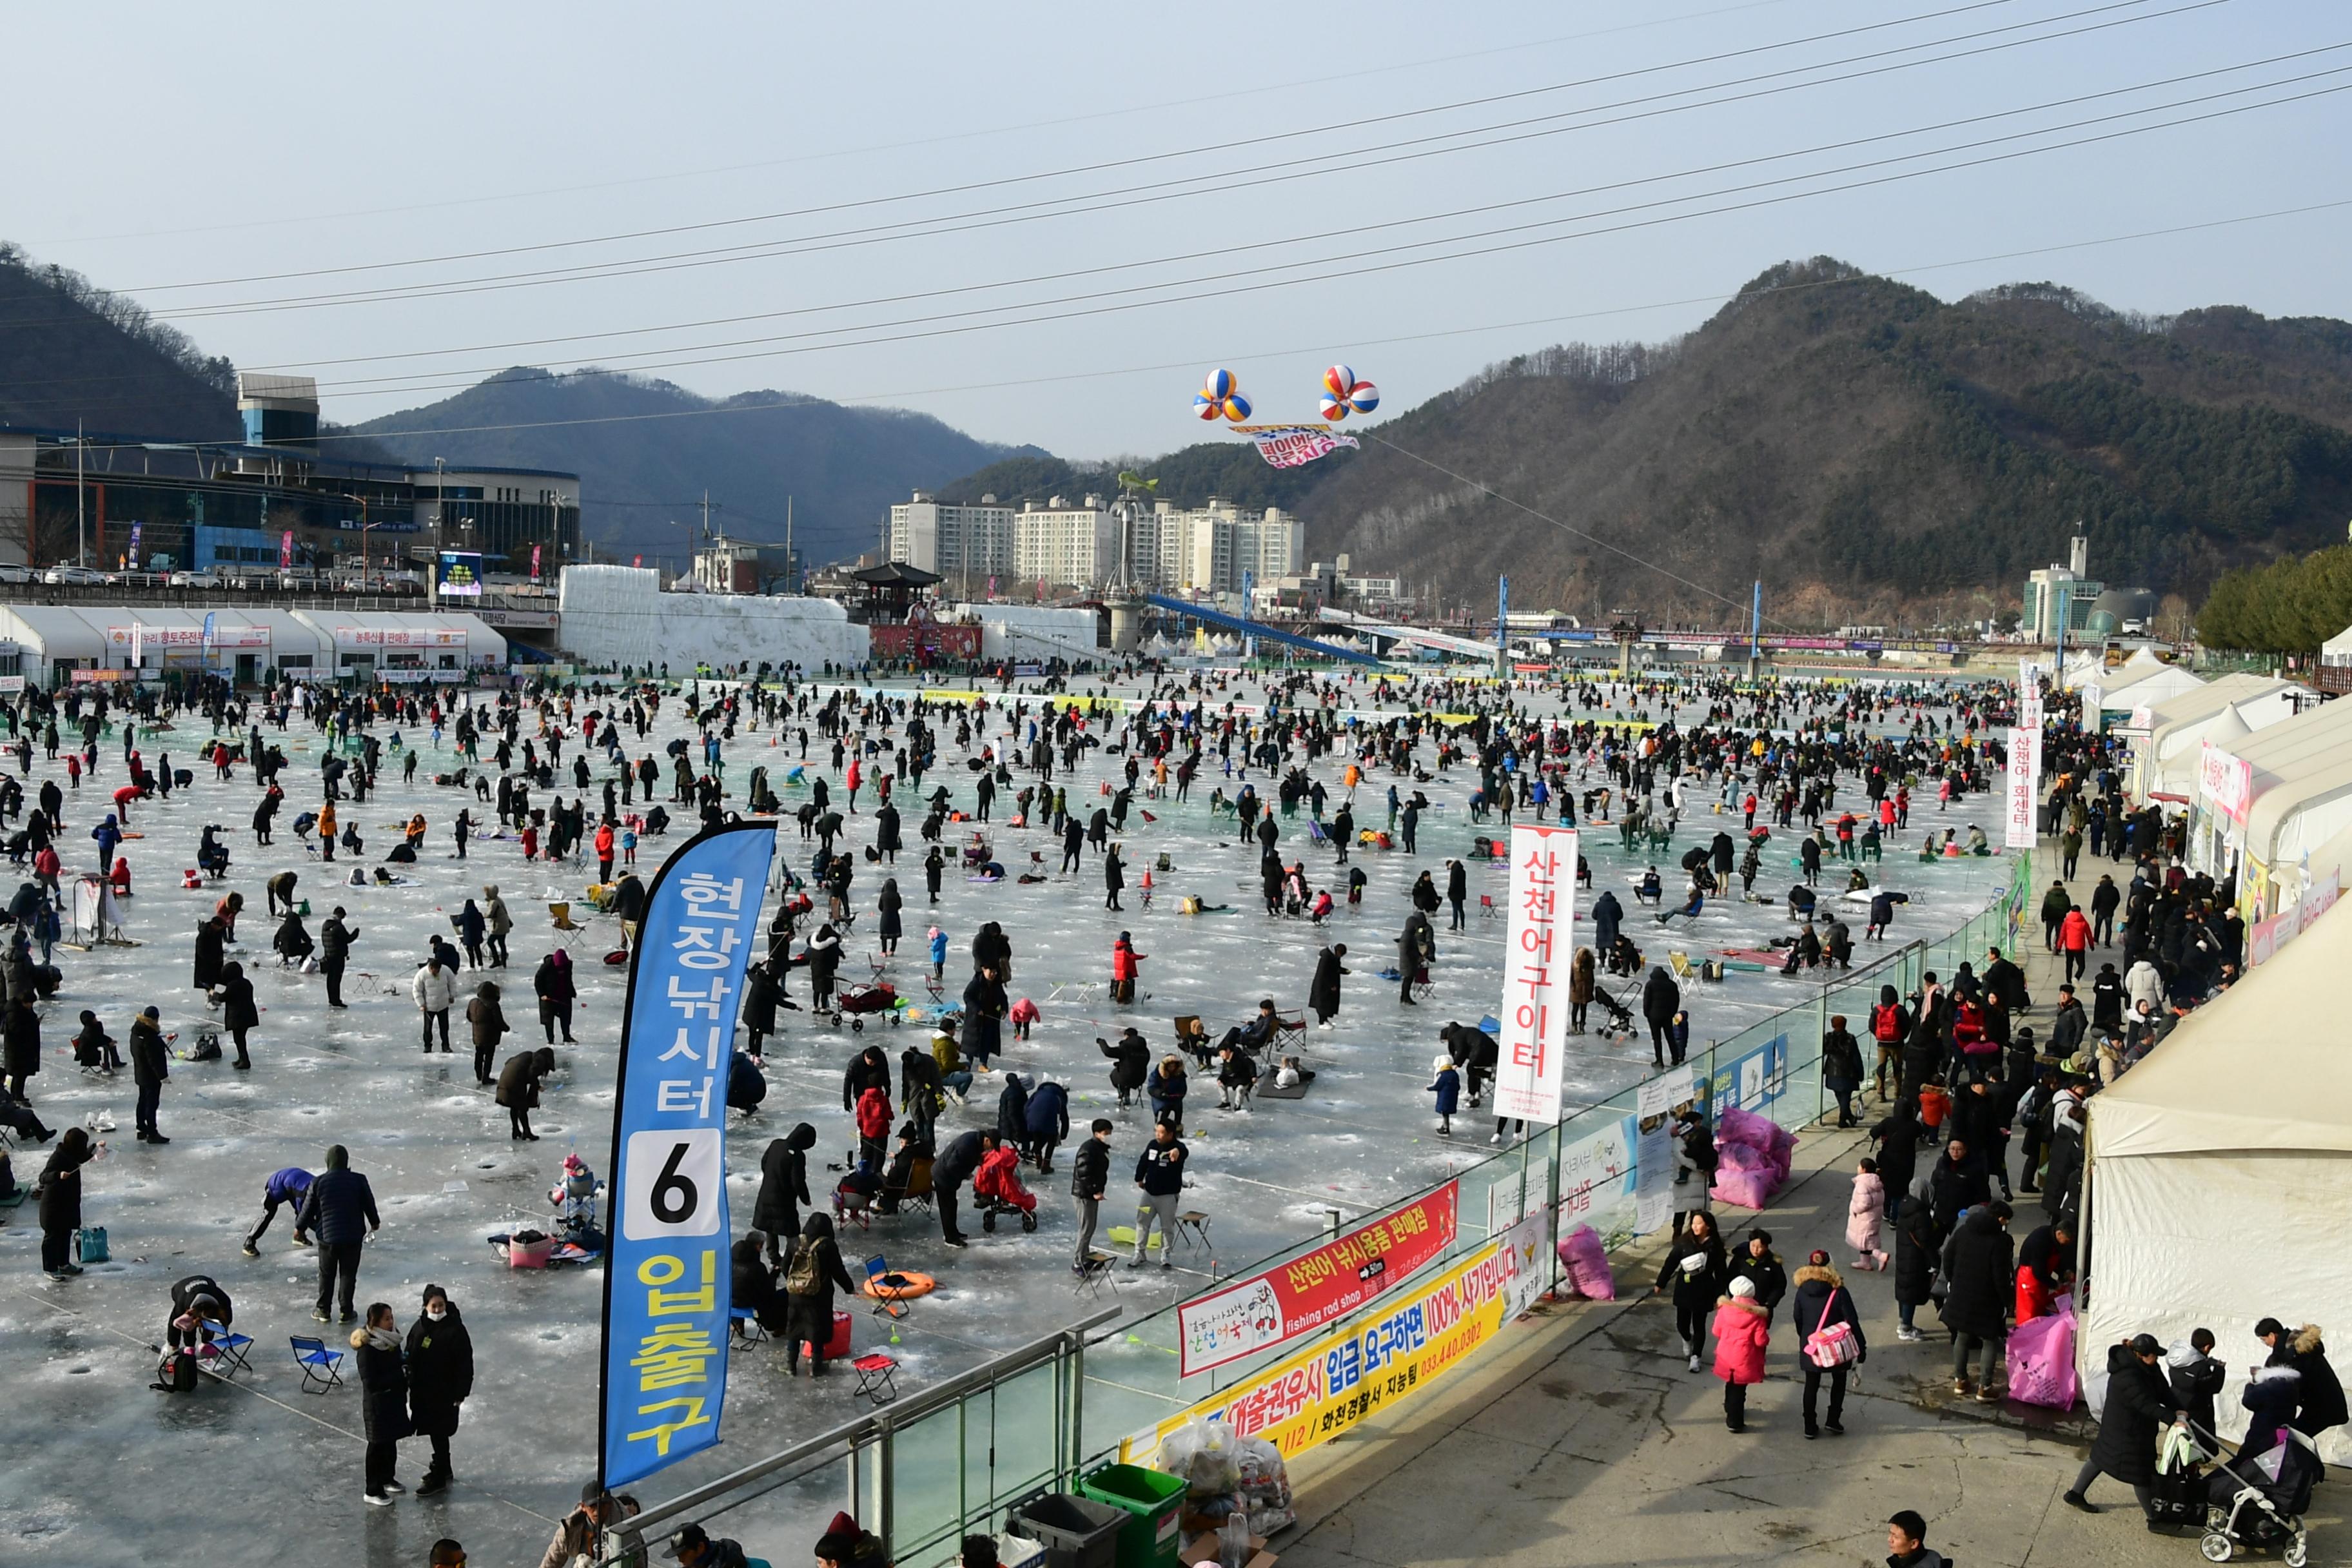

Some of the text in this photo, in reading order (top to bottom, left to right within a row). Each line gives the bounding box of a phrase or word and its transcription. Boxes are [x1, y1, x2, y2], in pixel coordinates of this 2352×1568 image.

[356, 632, 409, 644] 농특산물 판매장
[2014, 736, 2032, 779] 산천어
[2013, 785, 2029, 827] 회센터
[657, 872, 744, 1119] 현장낚시터
[1512, 850, 1560, 1079] 산천어구이터
[650, 1142, 698, 1224] 6
[1287, 1205, 1429, 1294] 산천어 낚시용품 판매점
[627, 1250, 718, 1456] 입출구
[1188, 1315, 1252, 1353] 산천어축제
[1228, 1358, 1323, 1439] 대출권유시
[1327, 1338, 1360, 1395] 입금
[1364, 1302, 1425, 1373] 요구하면
[1426, 1283, 1460, 1337] 100%
[1461, 1243, 1520, 1313] 사기입니다.
[1286, 1289, 1362, 1334] fishing rod shop
[1284, 1426, 1306, 1453] 112
[1320, 1385, 1382, 1432] 화천경찰서
[1386, 1363, 1417, 1396] 지능팀
[1420, 1321, 1482, 1377] 033.440.0302
